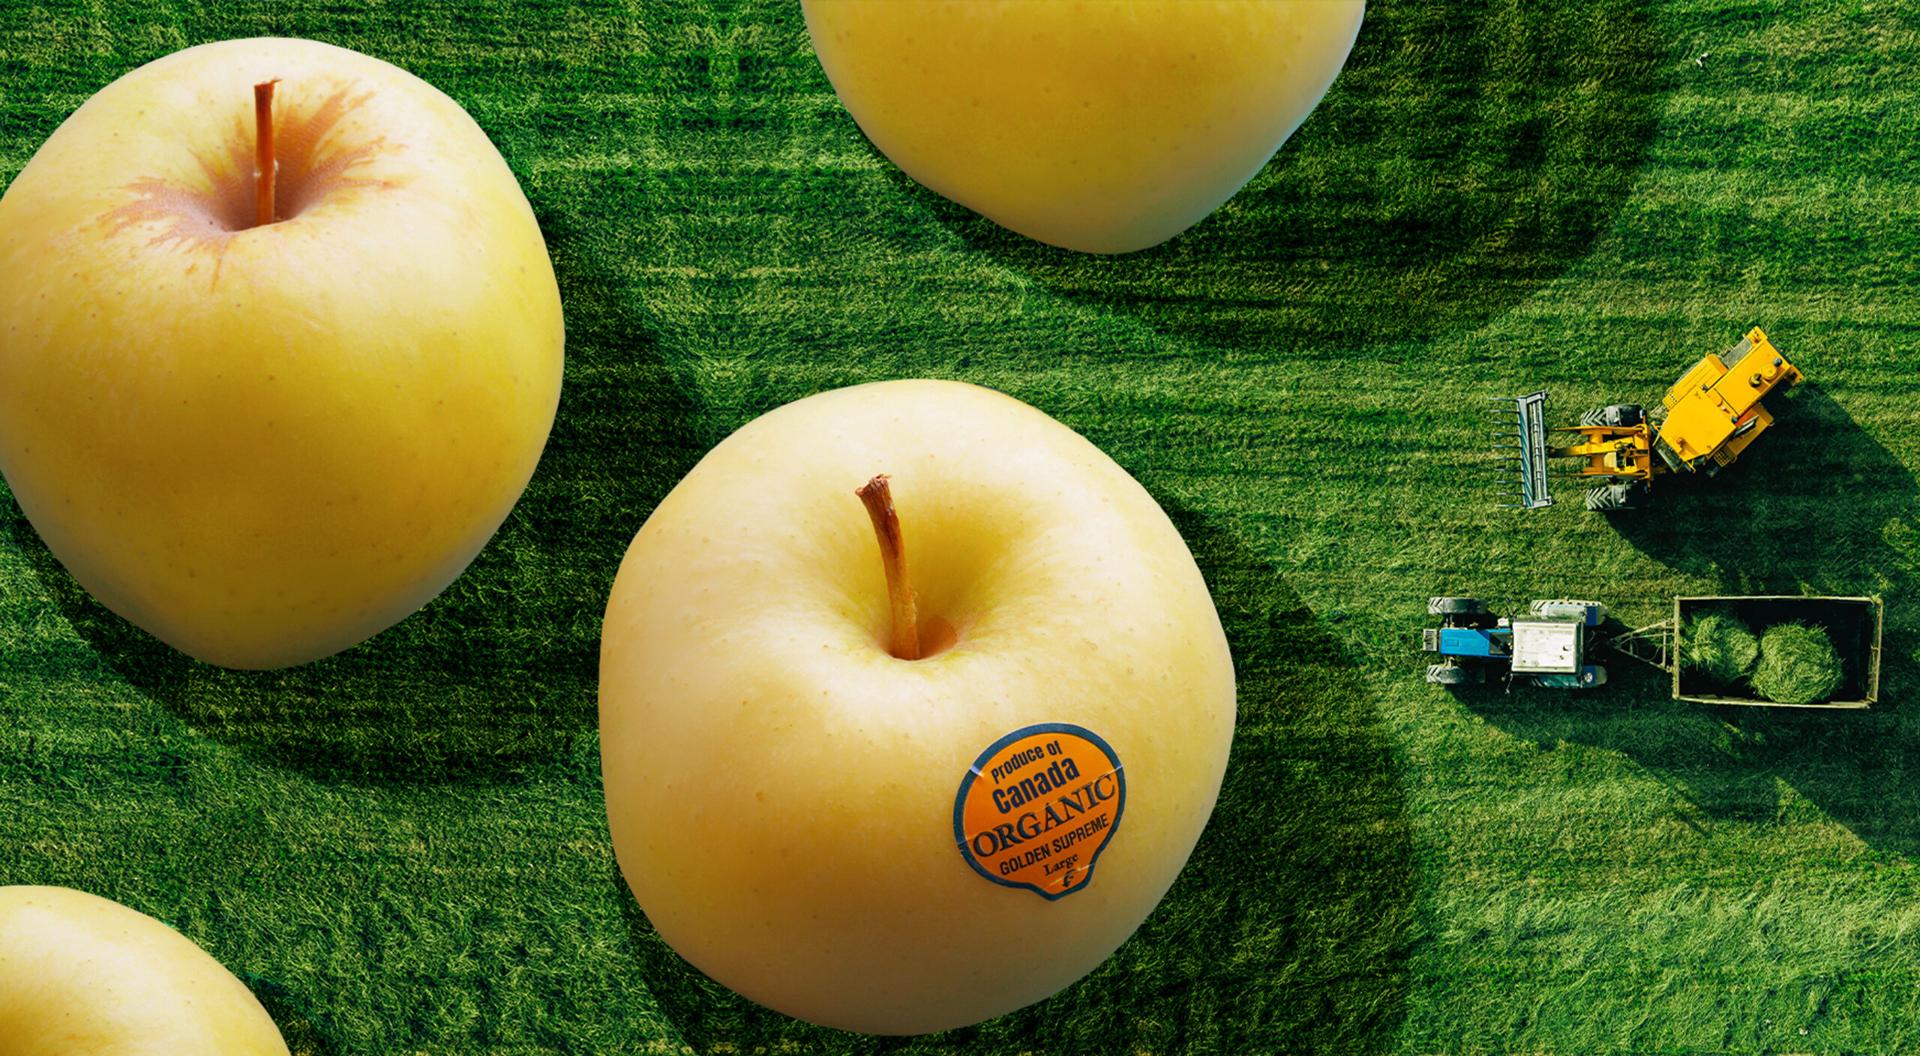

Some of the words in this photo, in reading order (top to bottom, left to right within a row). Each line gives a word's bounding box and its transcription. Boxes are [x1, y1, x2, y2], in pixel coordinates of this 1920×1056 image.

[991, 746, 1045, 785] Produce
[1046, 740, 1063, 756] of
[992, 757, 1080, 814] Canada
[973, 774, 1115, 858] ORGANIC
[1000, 845, 1052, 876] GOLDEN
[1052, 813, 1110, 853] SUPREME
[1043, 854, 1079, 876] Large
